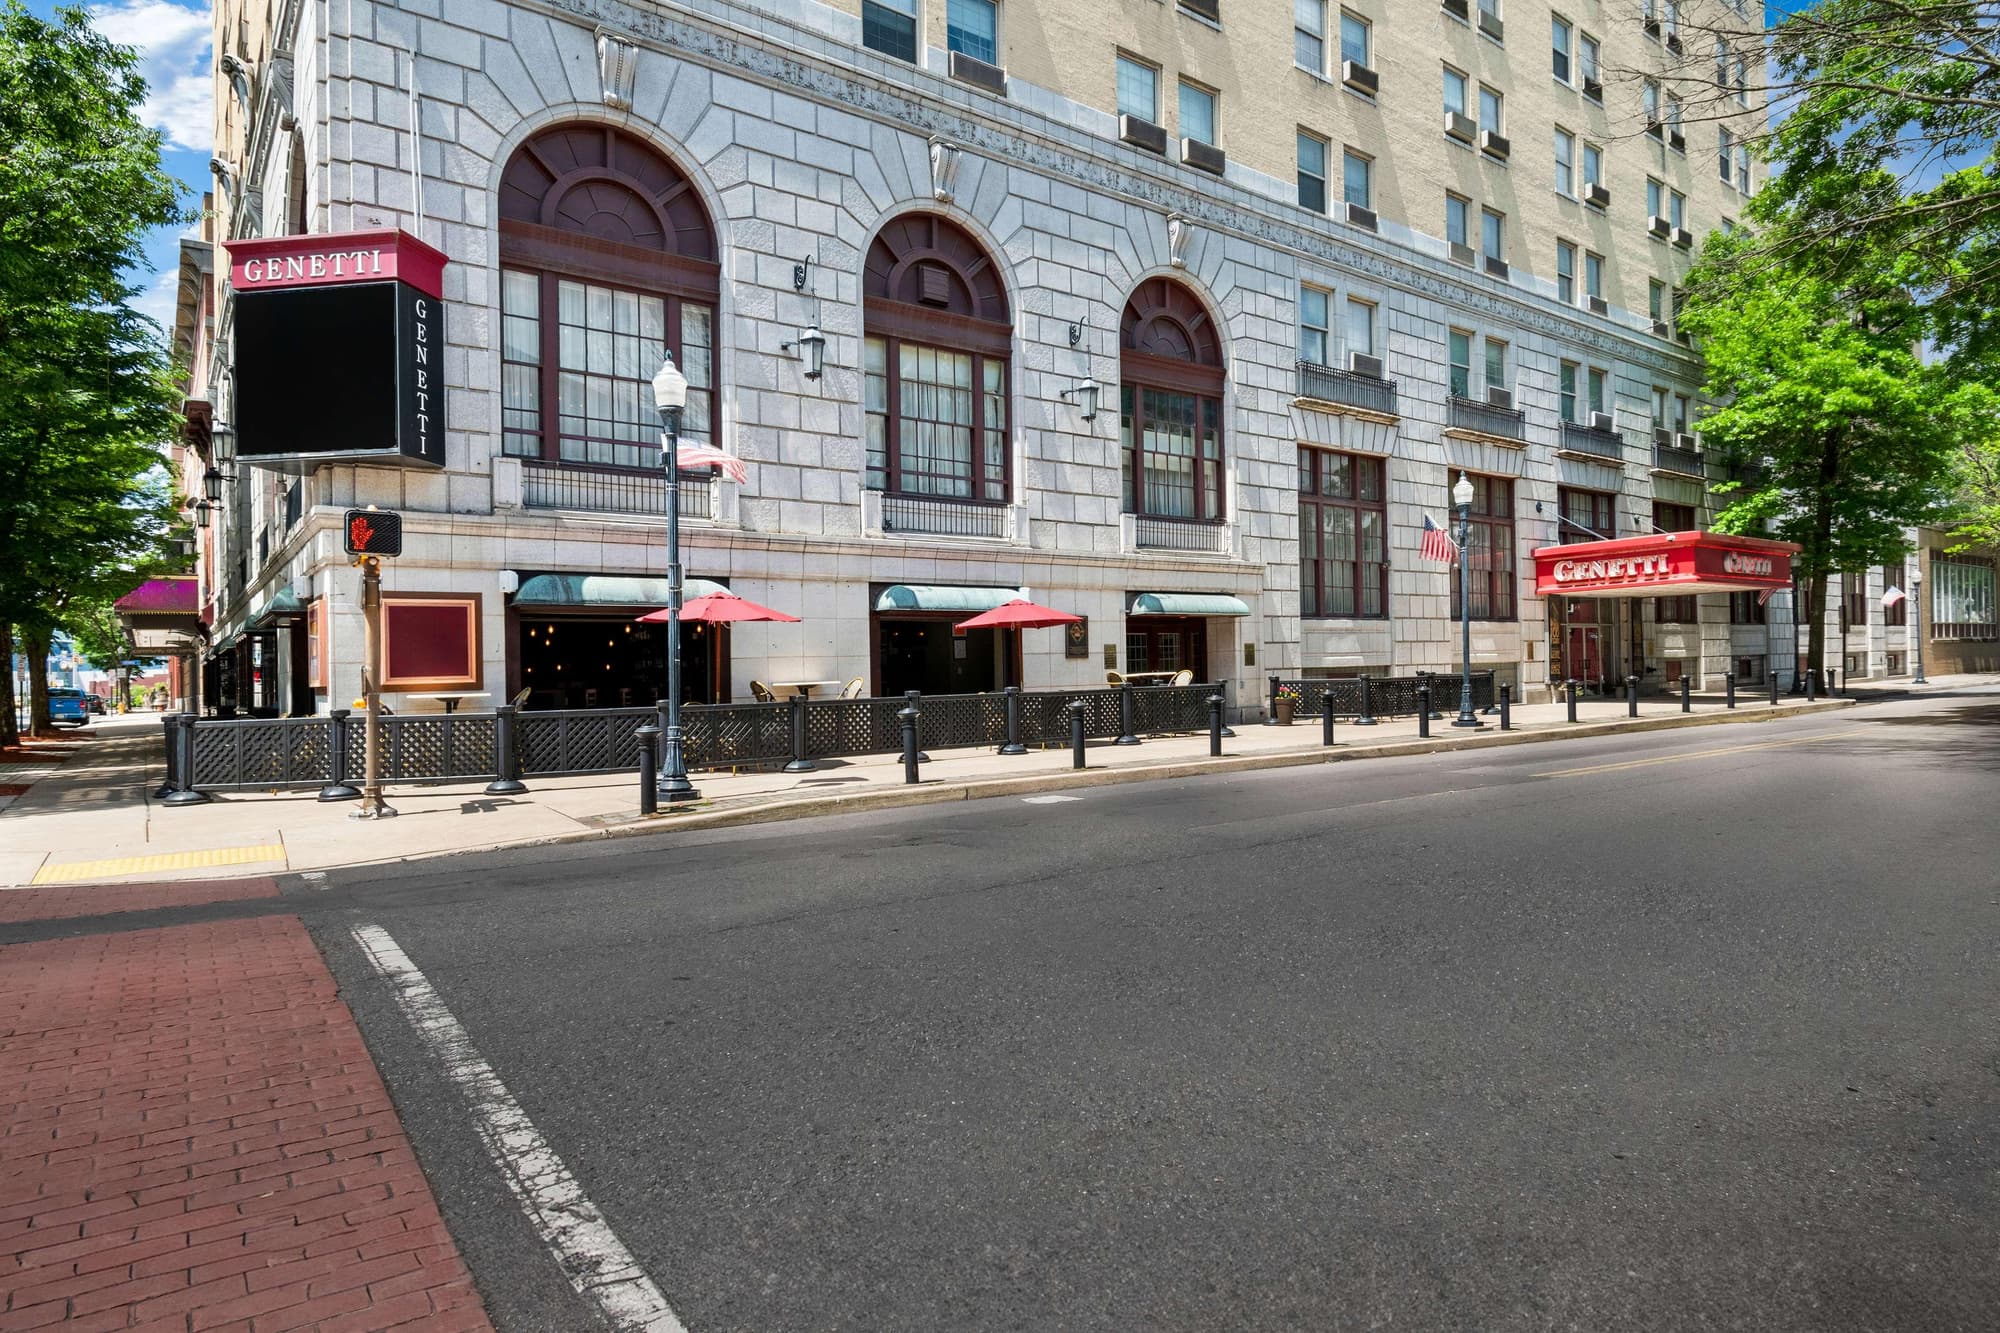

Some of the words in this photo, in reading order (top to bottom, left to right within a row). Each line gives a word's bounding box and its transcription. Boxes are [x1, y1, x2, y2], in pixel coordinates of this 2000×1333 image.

[244, 249, 381, 282] GENETTI
[415, 299, 429, 455] GENETTI
[1553, 553, 1669, 582] GENETTI
